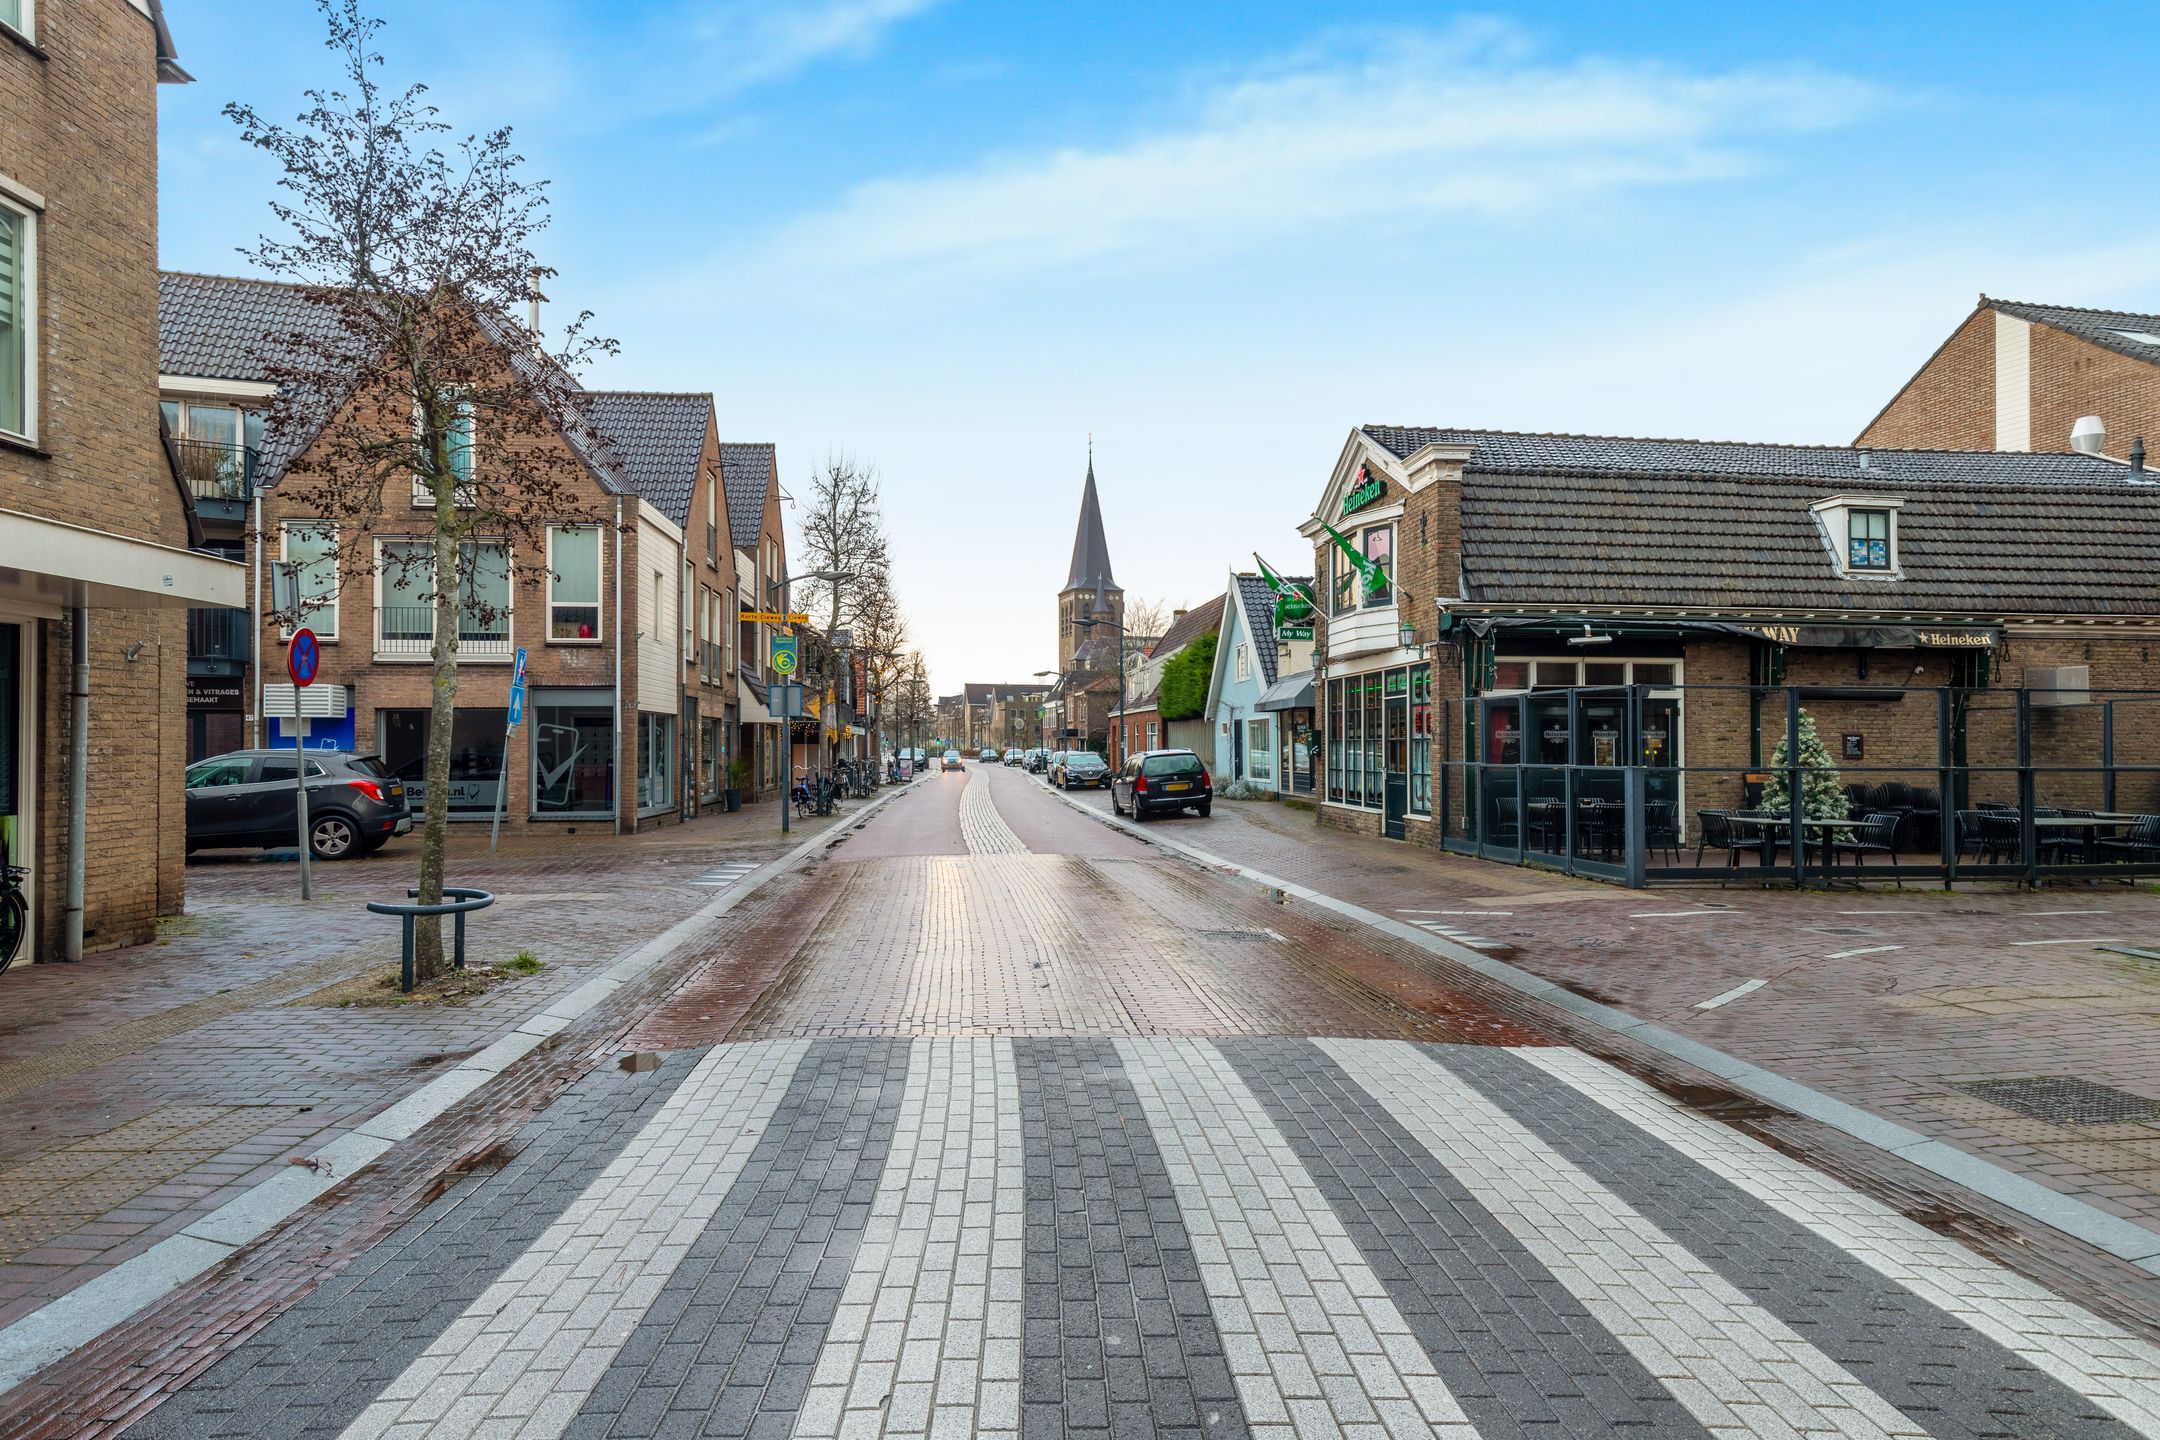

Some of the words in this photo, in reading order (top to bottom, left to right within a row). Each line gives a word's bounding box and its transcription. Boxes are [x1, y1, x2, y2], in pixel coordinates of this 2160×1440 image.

[1343, 480, 1381, 516] Heineken
[1281, 630, 1294, 638] My
[1296, 630, 1312, 638] Way
[1761, 626, 1800, 642] WAY
[1930, 631, 1992, 645] Heineken
